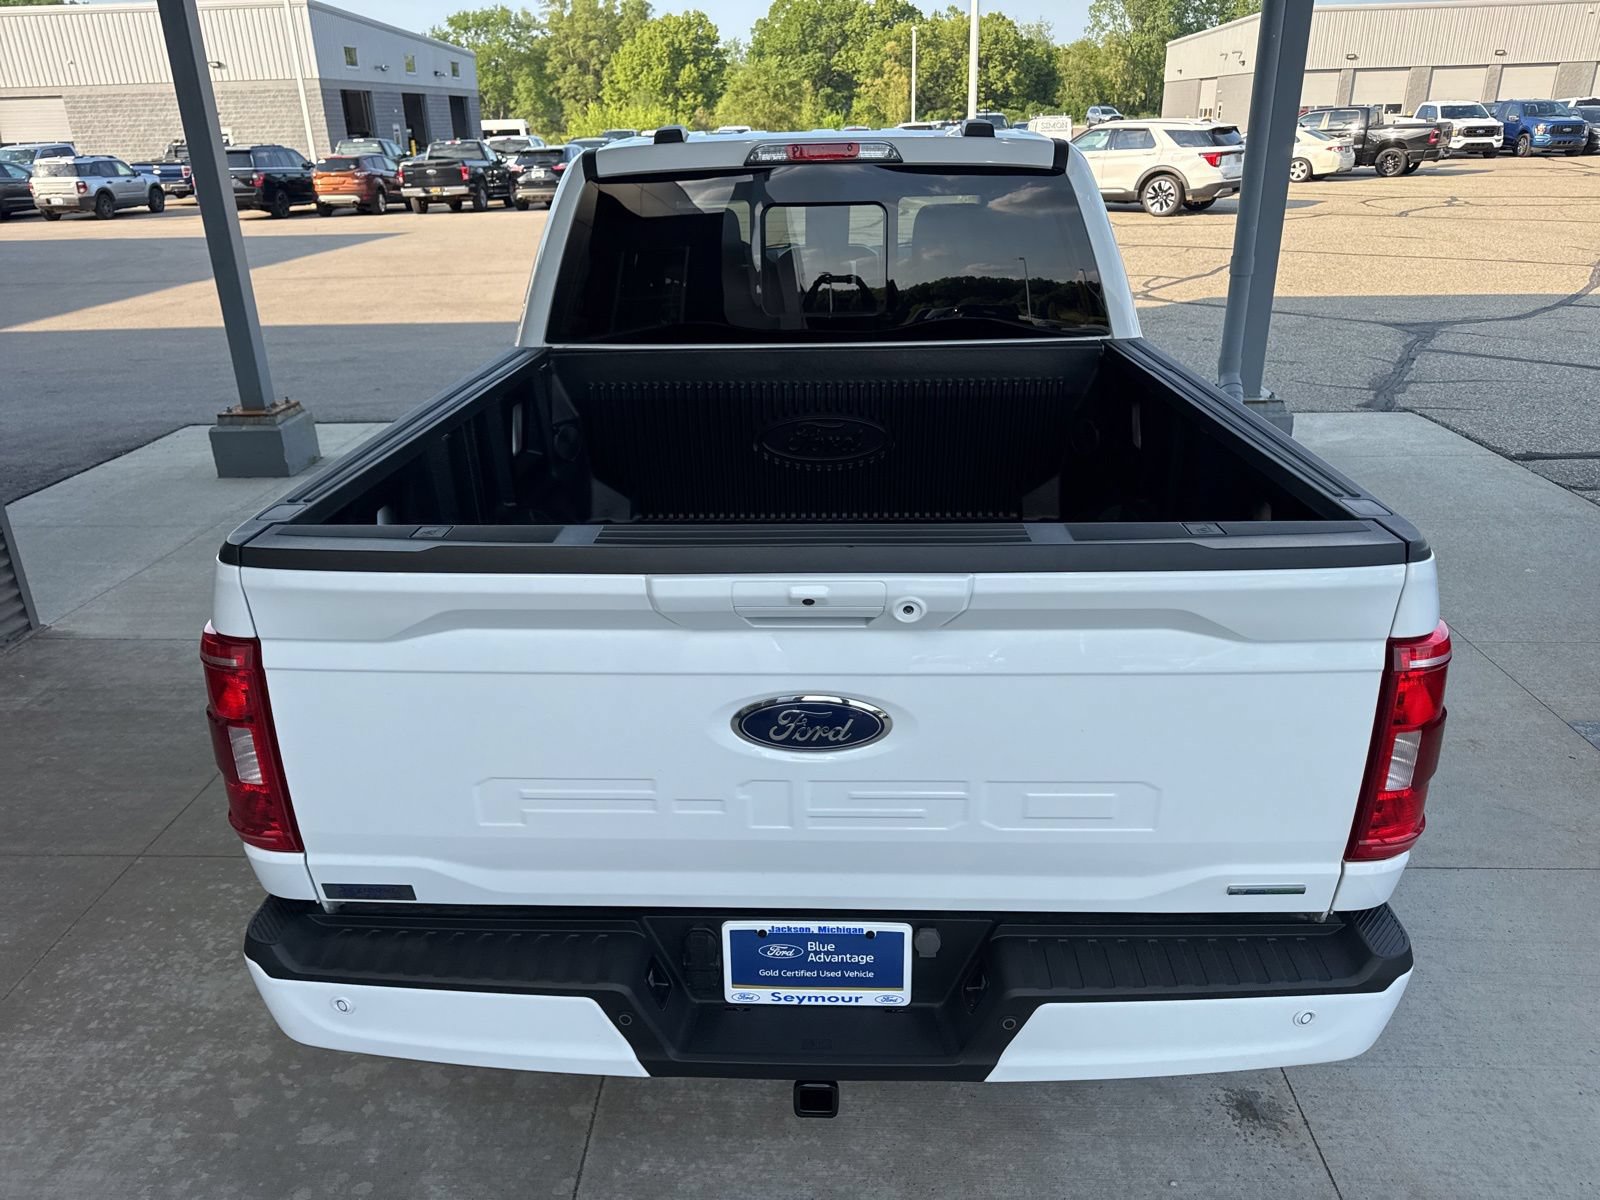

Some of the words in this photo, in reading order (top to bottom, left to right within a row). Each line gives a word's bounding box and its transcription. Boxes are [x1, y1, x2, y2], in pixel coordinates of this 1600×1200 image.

[788, 421, 864, 453] Ford
[769, 709, 854, 742] Ford
[474, 776, 1162, 832] F-150
[768, 925, 815, 934] Jackson,
[818, 926, 864, 935] Michigan
[766, 945, 795, 957] Ford
[807, 941, 836, 952] Blue
[807, 952, 875, 965] Advantage
[758, 969, 779, 977] Gold
[781, 969, 817, 978] Certified
[819, 970, 842, 978] Used
[843, 970, 875, 978] Vehicle
[737, 992, 755, 1001] Ford
[770, 991, 864, 1006] Seymour
[880, 995, 899, 1004] Ford
